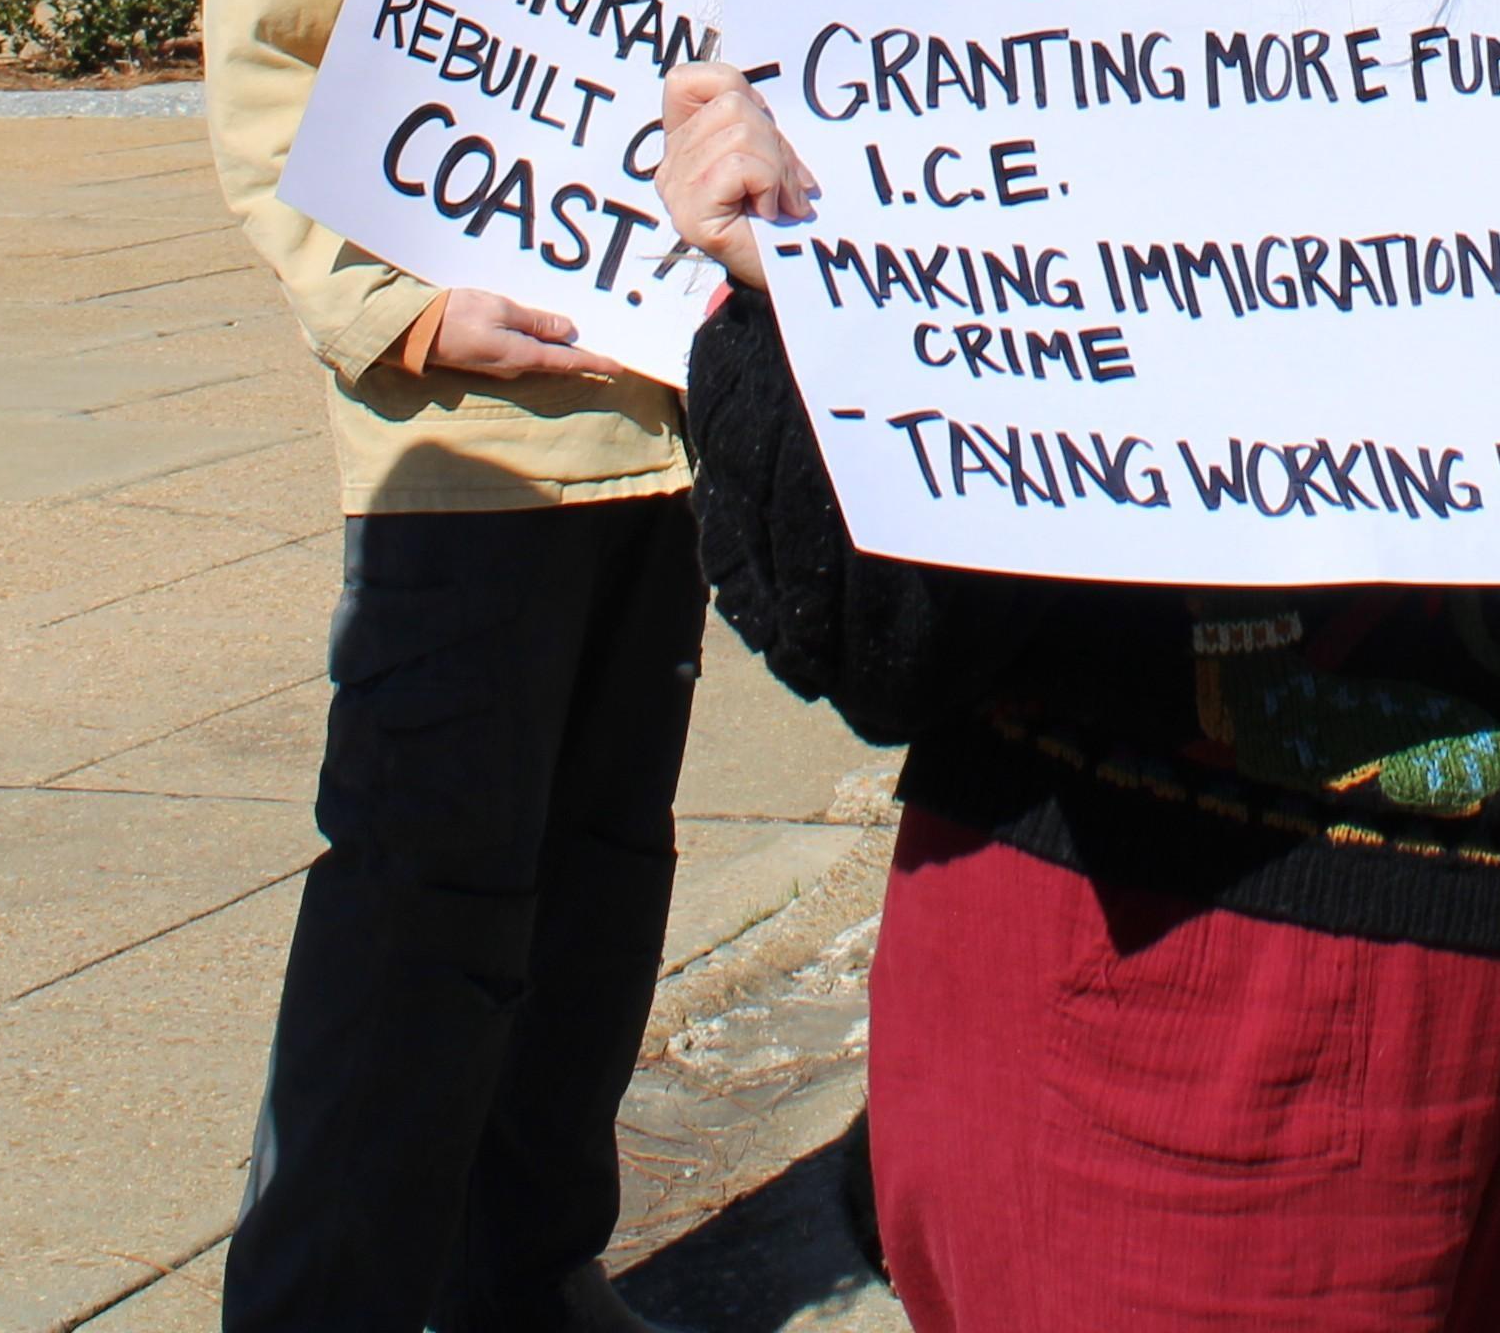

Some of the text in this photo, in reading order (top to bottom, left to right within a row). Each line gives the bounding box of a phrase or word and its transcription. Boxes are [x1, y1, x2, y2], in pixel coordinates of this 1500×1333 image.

[802, 22, 1184, 119] GRANTING
[1206, 28, 1388, 115] MORE
[866, 139, 1069, 207] I.C.E.
[915, 322, 1136, 383] CRIME
[887, 410, 1168, 510] TAXING
[1178, 436, 1482, 521] WORKING
